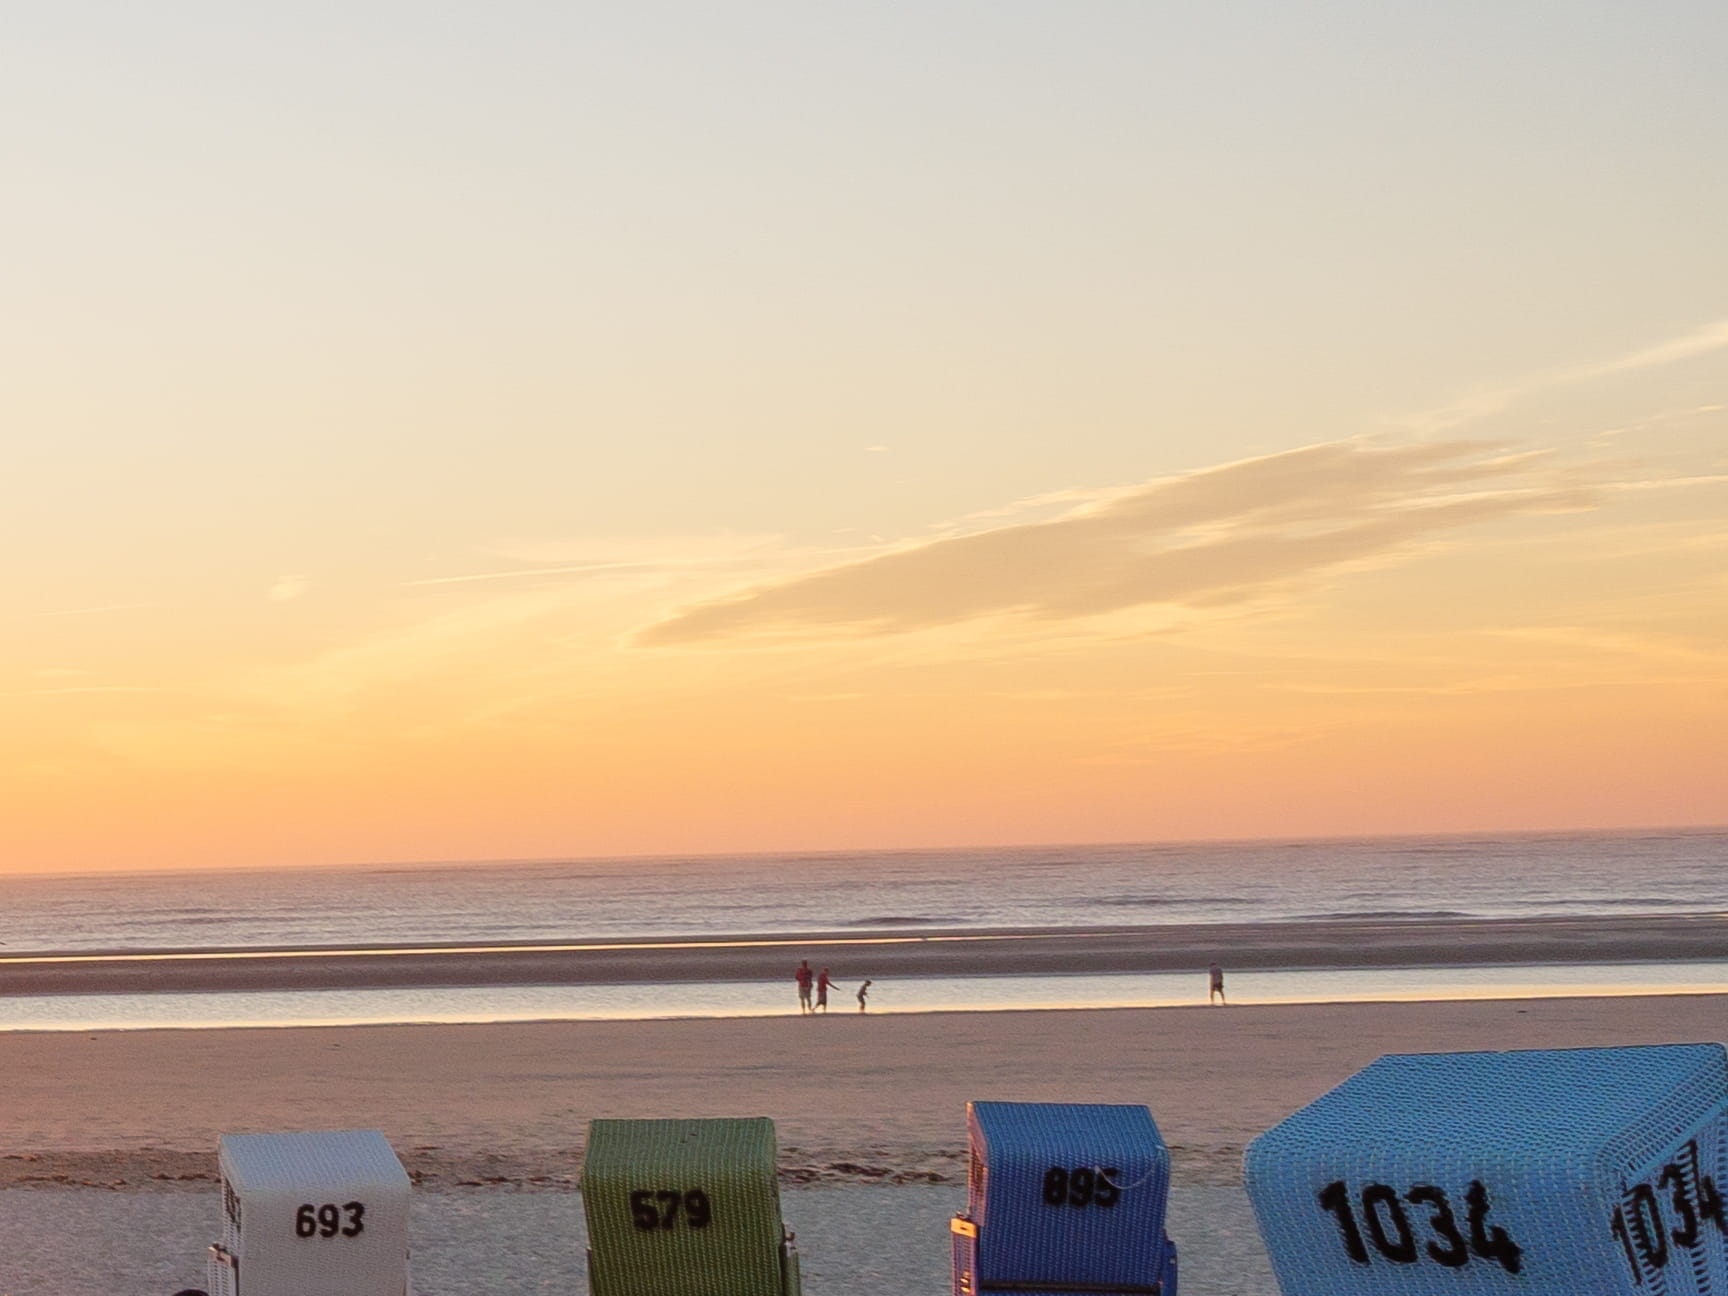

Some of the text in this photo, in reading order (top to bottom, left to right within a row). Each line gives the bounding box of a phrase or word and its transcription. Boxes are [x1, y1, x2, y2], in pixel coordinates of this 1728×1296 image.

[1043, 1166, 1121, 1209] 895
[296, 1201, 364, 1238] 693
[630, 1189, 712, 1230] 579
[1318, 1179, 1524, 1275] 1034
